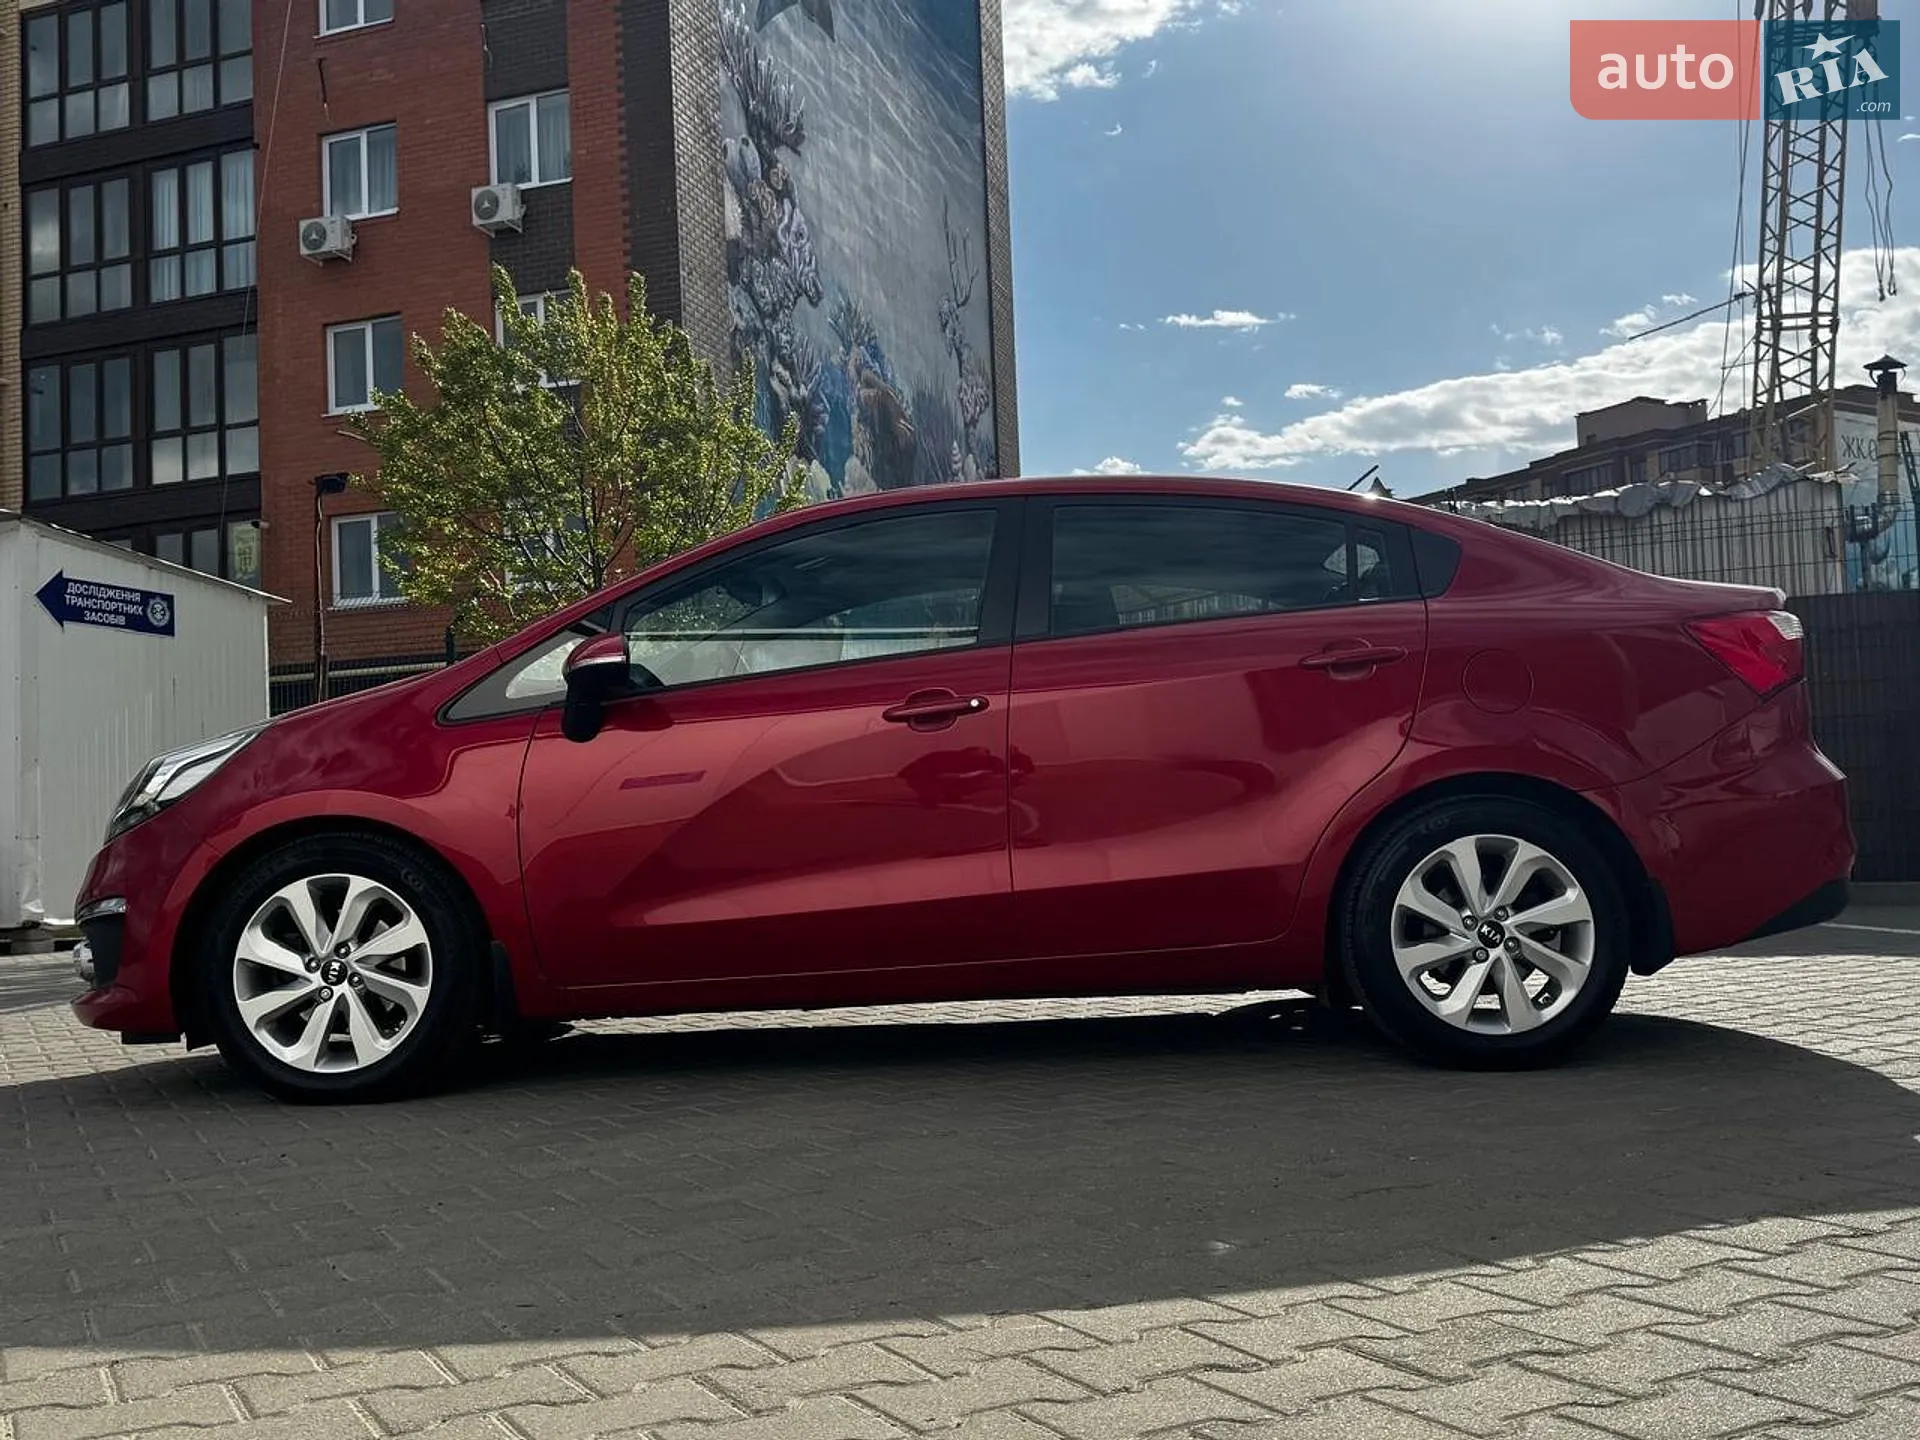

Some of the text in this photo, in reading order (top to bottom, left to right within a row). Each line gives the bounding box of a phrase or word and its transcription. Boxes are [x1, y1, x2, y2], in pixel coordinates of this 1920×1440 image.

[67, 582, 141, 602] ДОСЛІДЖЕННЯ
[64, 595, 144, 616] ТРАНСПОРТНИХ
[83, 610, 126, 625] ЗАСОБІВ
[1480, 924, 1501, 944] KIA
[328, 961, 341, 983] KIA
